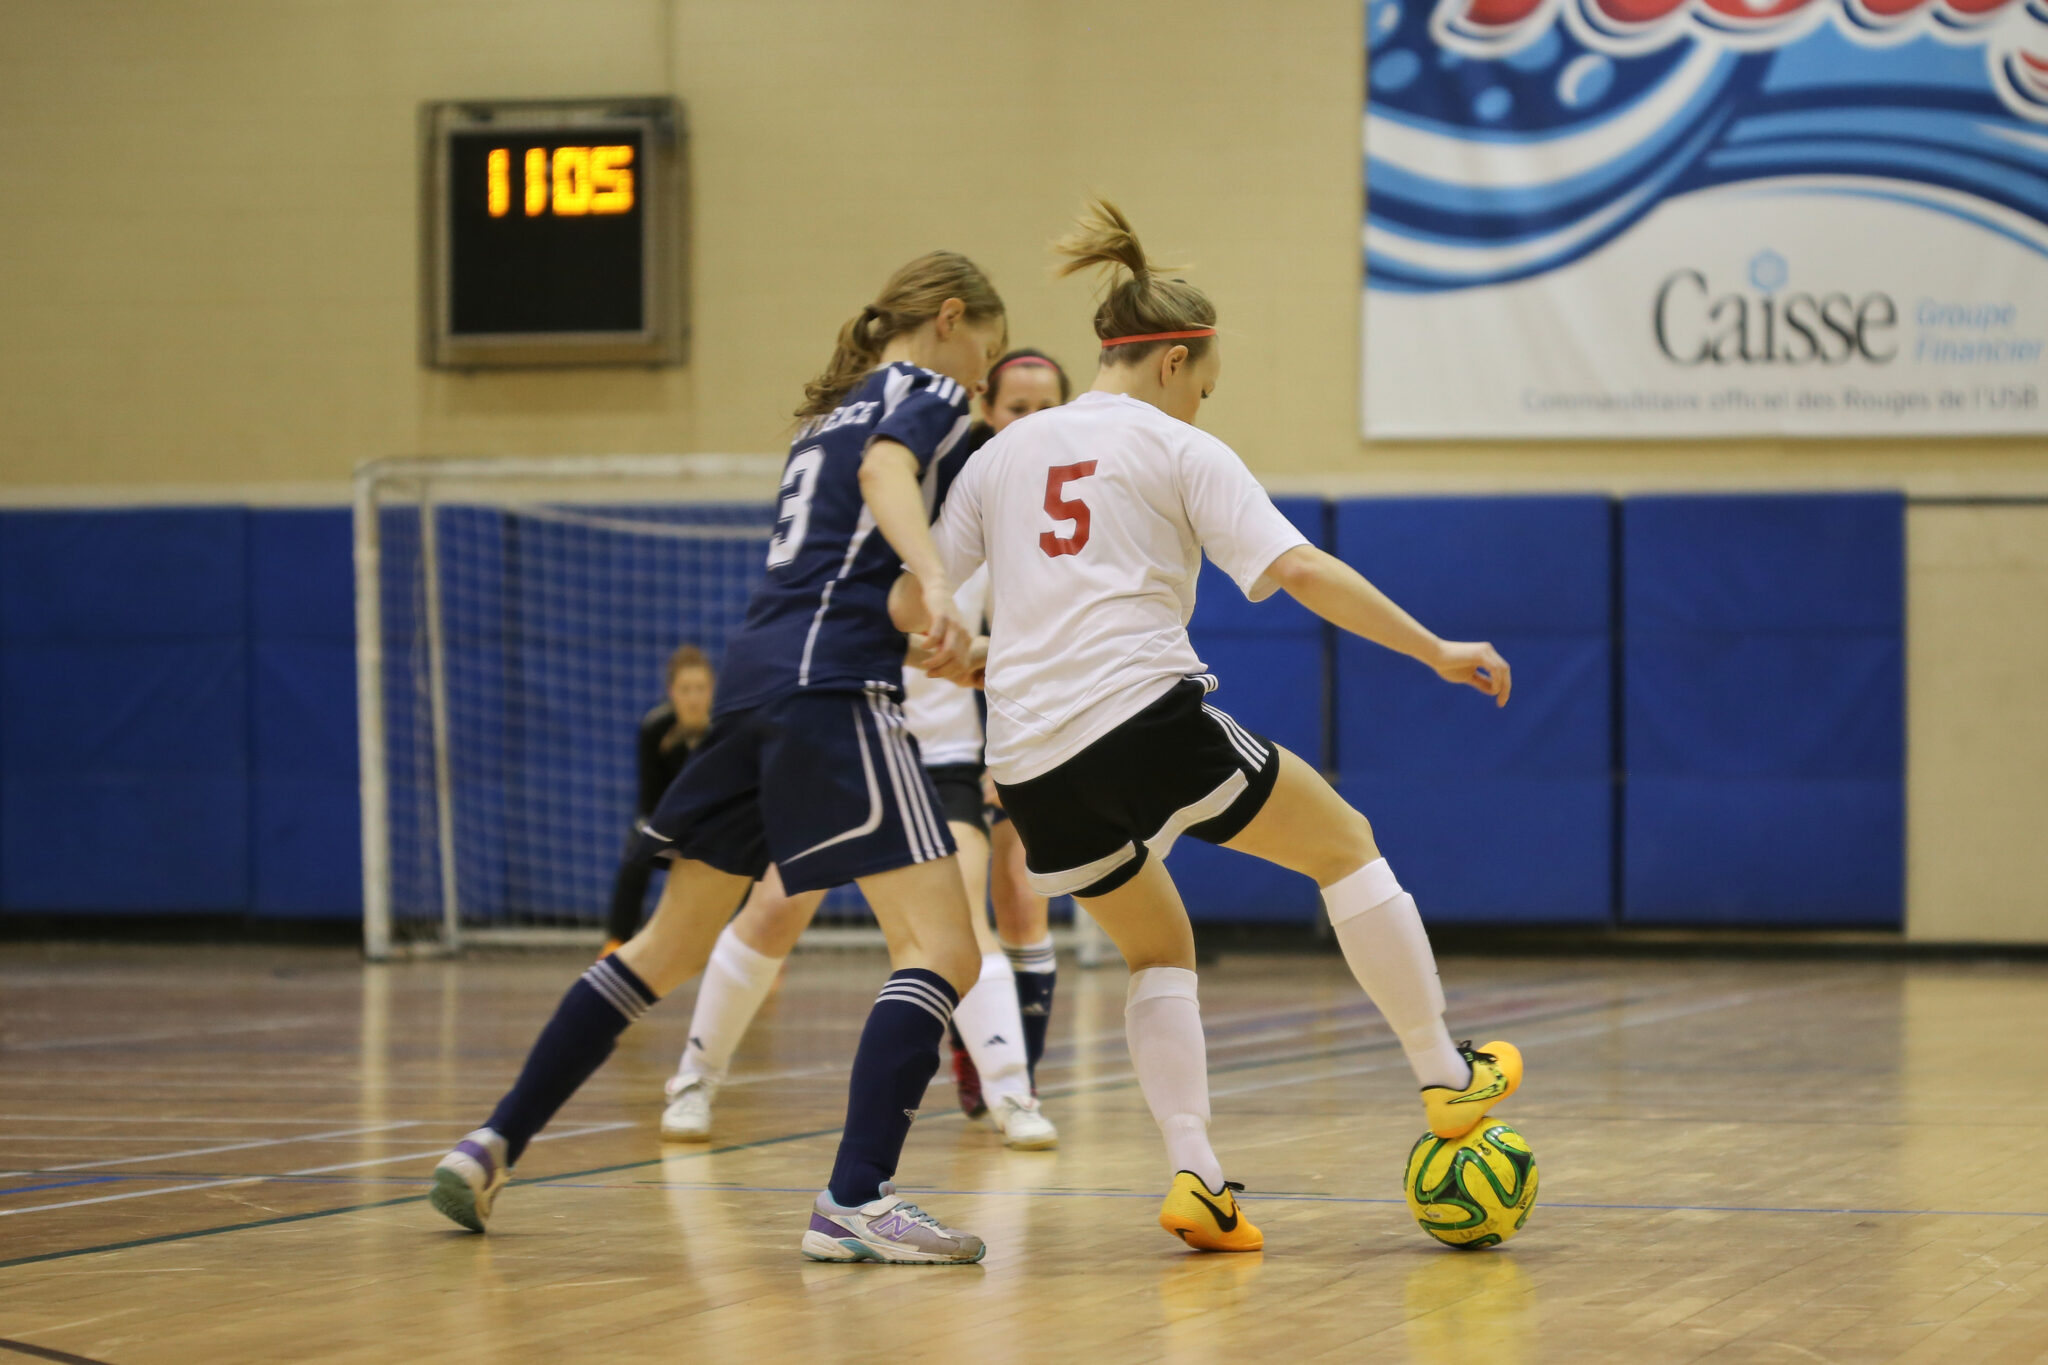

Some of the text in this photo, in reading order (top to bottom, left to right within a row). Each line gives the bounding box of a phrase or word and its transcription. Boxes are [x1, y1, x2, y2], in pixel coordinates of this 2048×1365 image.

[1652, 250, 1899, 367] Caisse
[1914, 297, 2017, 332] Groupe
[1913, 337, 2046, 365] Financier
[1708, 386, 1790, 411] officiel
[1797, 388, 1837, 411] des
[1843, 387, 1931, 417] Rouges
[1937, 387, 1966, 411] de
[766, 445, 825, 571] 3
[1039, 459, 1098, 558] 5
[1460, 1218, 1499, 1240] USB
